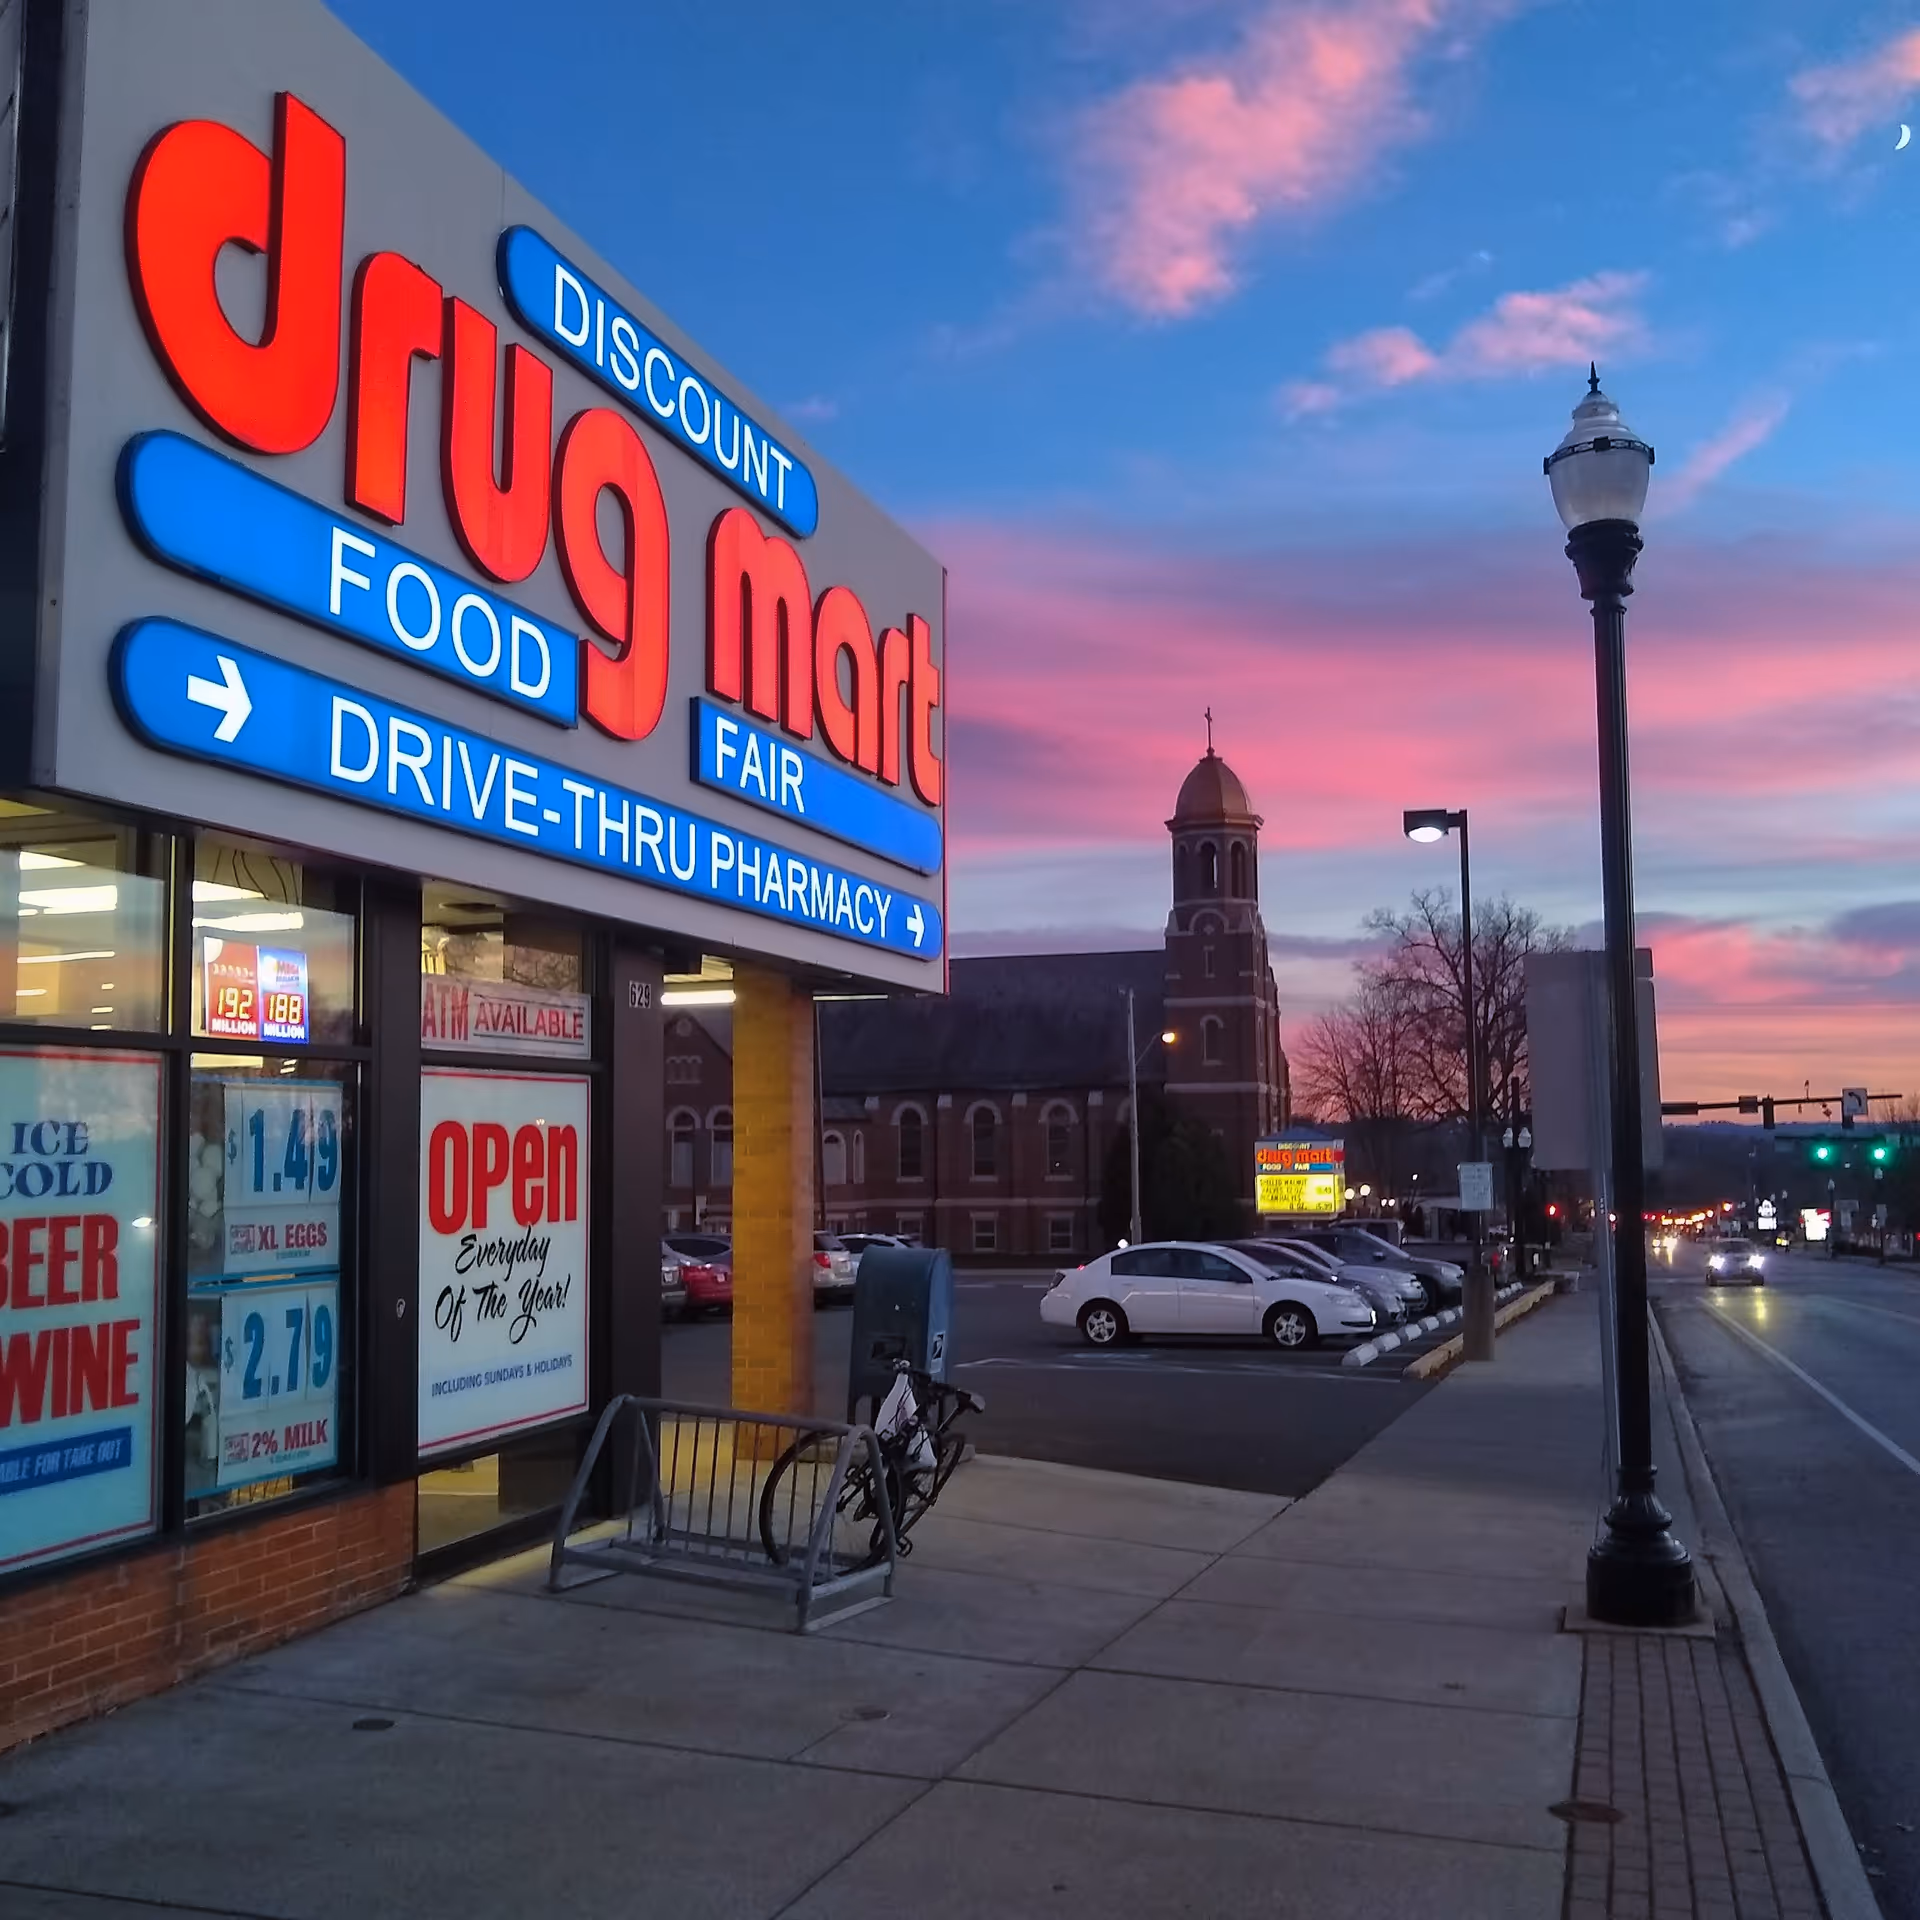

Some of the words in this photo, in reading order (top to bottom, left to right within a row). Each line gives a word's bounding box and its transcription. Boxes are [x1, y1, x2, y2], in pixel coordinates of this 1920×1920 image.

[554, 263, 793, 511] DISCOUNT
[127, 91, 669, 741] drug
[706, 506, 942, 807] mart
[329, 525, 552, 699] FOOD
[715, 715, 806, 814] FAIR
[330, 695, 697, 881] DRIVE-THRU
[711, 831, 893, 939] PHARMACY
[217, 987, 254, 1020] 192
[268, 993, 303, 1025] 188
[421, 981, 470, 1042] ATM
[474, 1001, 585, 1040] AVAILABLE
[629, 982, 651, 1007] 629
[211, 1017, 258, 1036] MILLION
[263, 1022, 306, 1040] MILLION
[11, 1120, 90, 1156] ICE
[1295, 1147, 1332, 1163] mart
[257, 1224, 279, 1251] XL
[285, 1221, 328, 1249] EGGS
[454, 1224, 551, 1282] Everyday
[0, 1212, 119, 1310] EER
[434, 1284, 467, 1343] Of
[471, 1280, 508, 1323] The
[509, 1273, 571, 1345] Year!
[0, 1318, 141, 1429] WINE
[431, 1372, 483, 1398] INCLUDING
[484, 1364, 524, 1386] SUNDAYS
[526, 1363, 533, 1377] &
[534, 1354, 573, 1375] HOLIDAYS
[34, 1449, 61, 1477] FOR
[63, 1442, 95, 1473] TAKE
[97, 1439, 122, 1464] OUT
[251, 1429, 278, 1458] 2%
[284, 1418, 329, 1451] MILK
